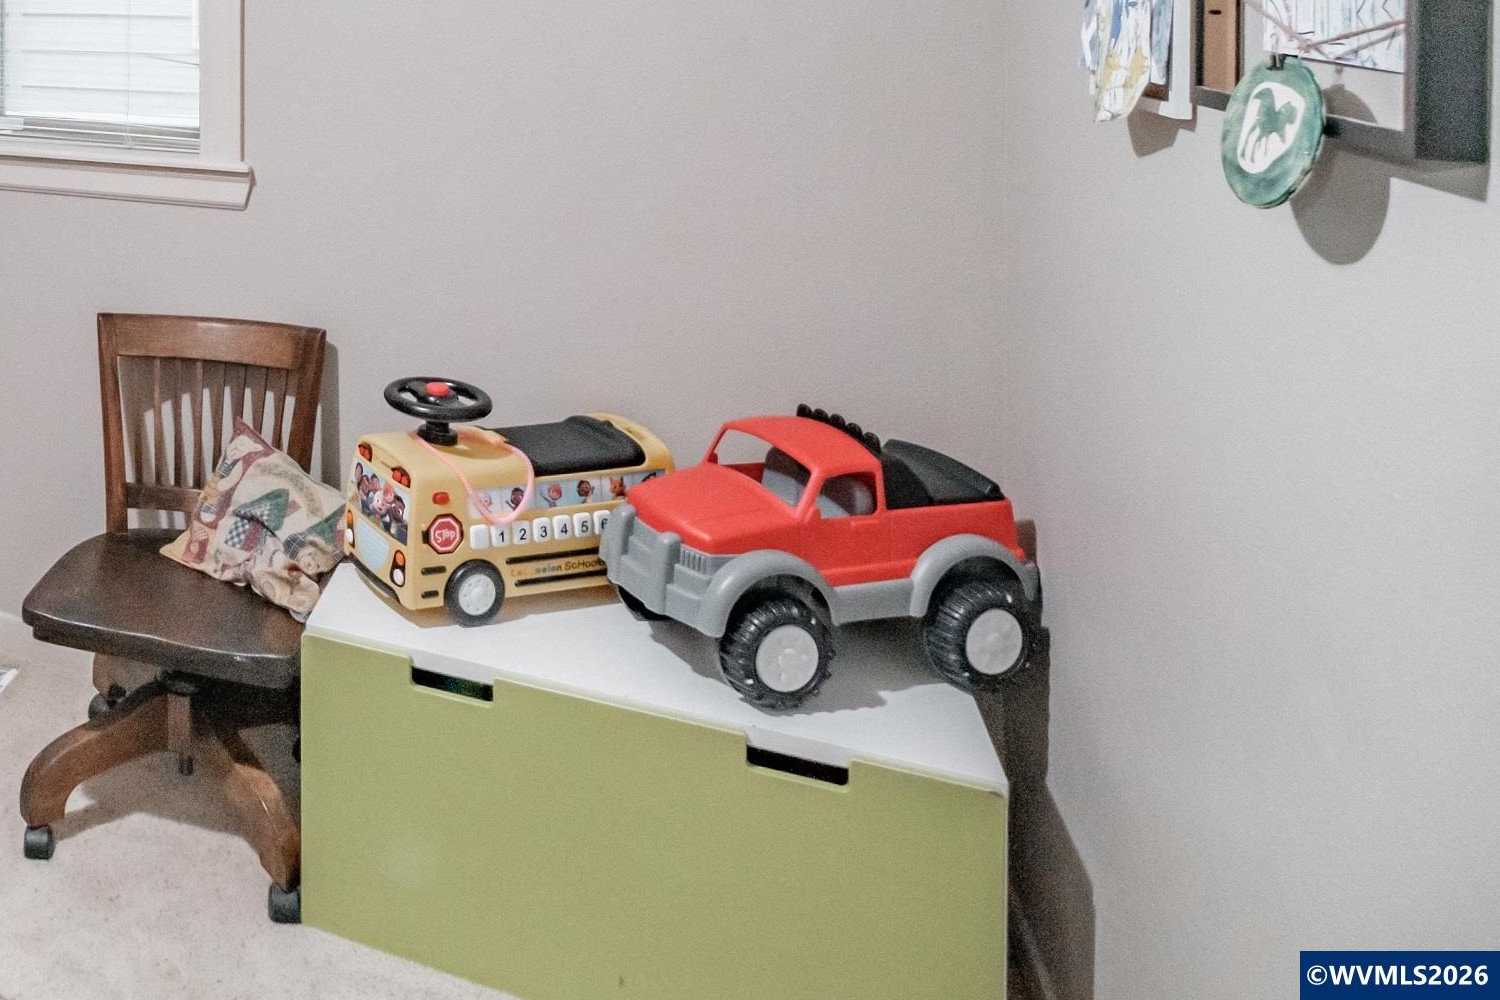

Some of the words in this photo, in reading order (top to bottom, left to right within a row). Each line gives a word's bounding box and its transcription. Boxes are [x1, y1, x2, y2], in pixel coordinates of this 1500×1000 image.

[434, 528, 456, 544] STOP
[498, 531, 505, 543] 1
[519, 528, 528, 540] 2
[540, 525, 548, 538] 3
[560, 523, 568, 534] 4
[581, 521, 589, 533] 5
